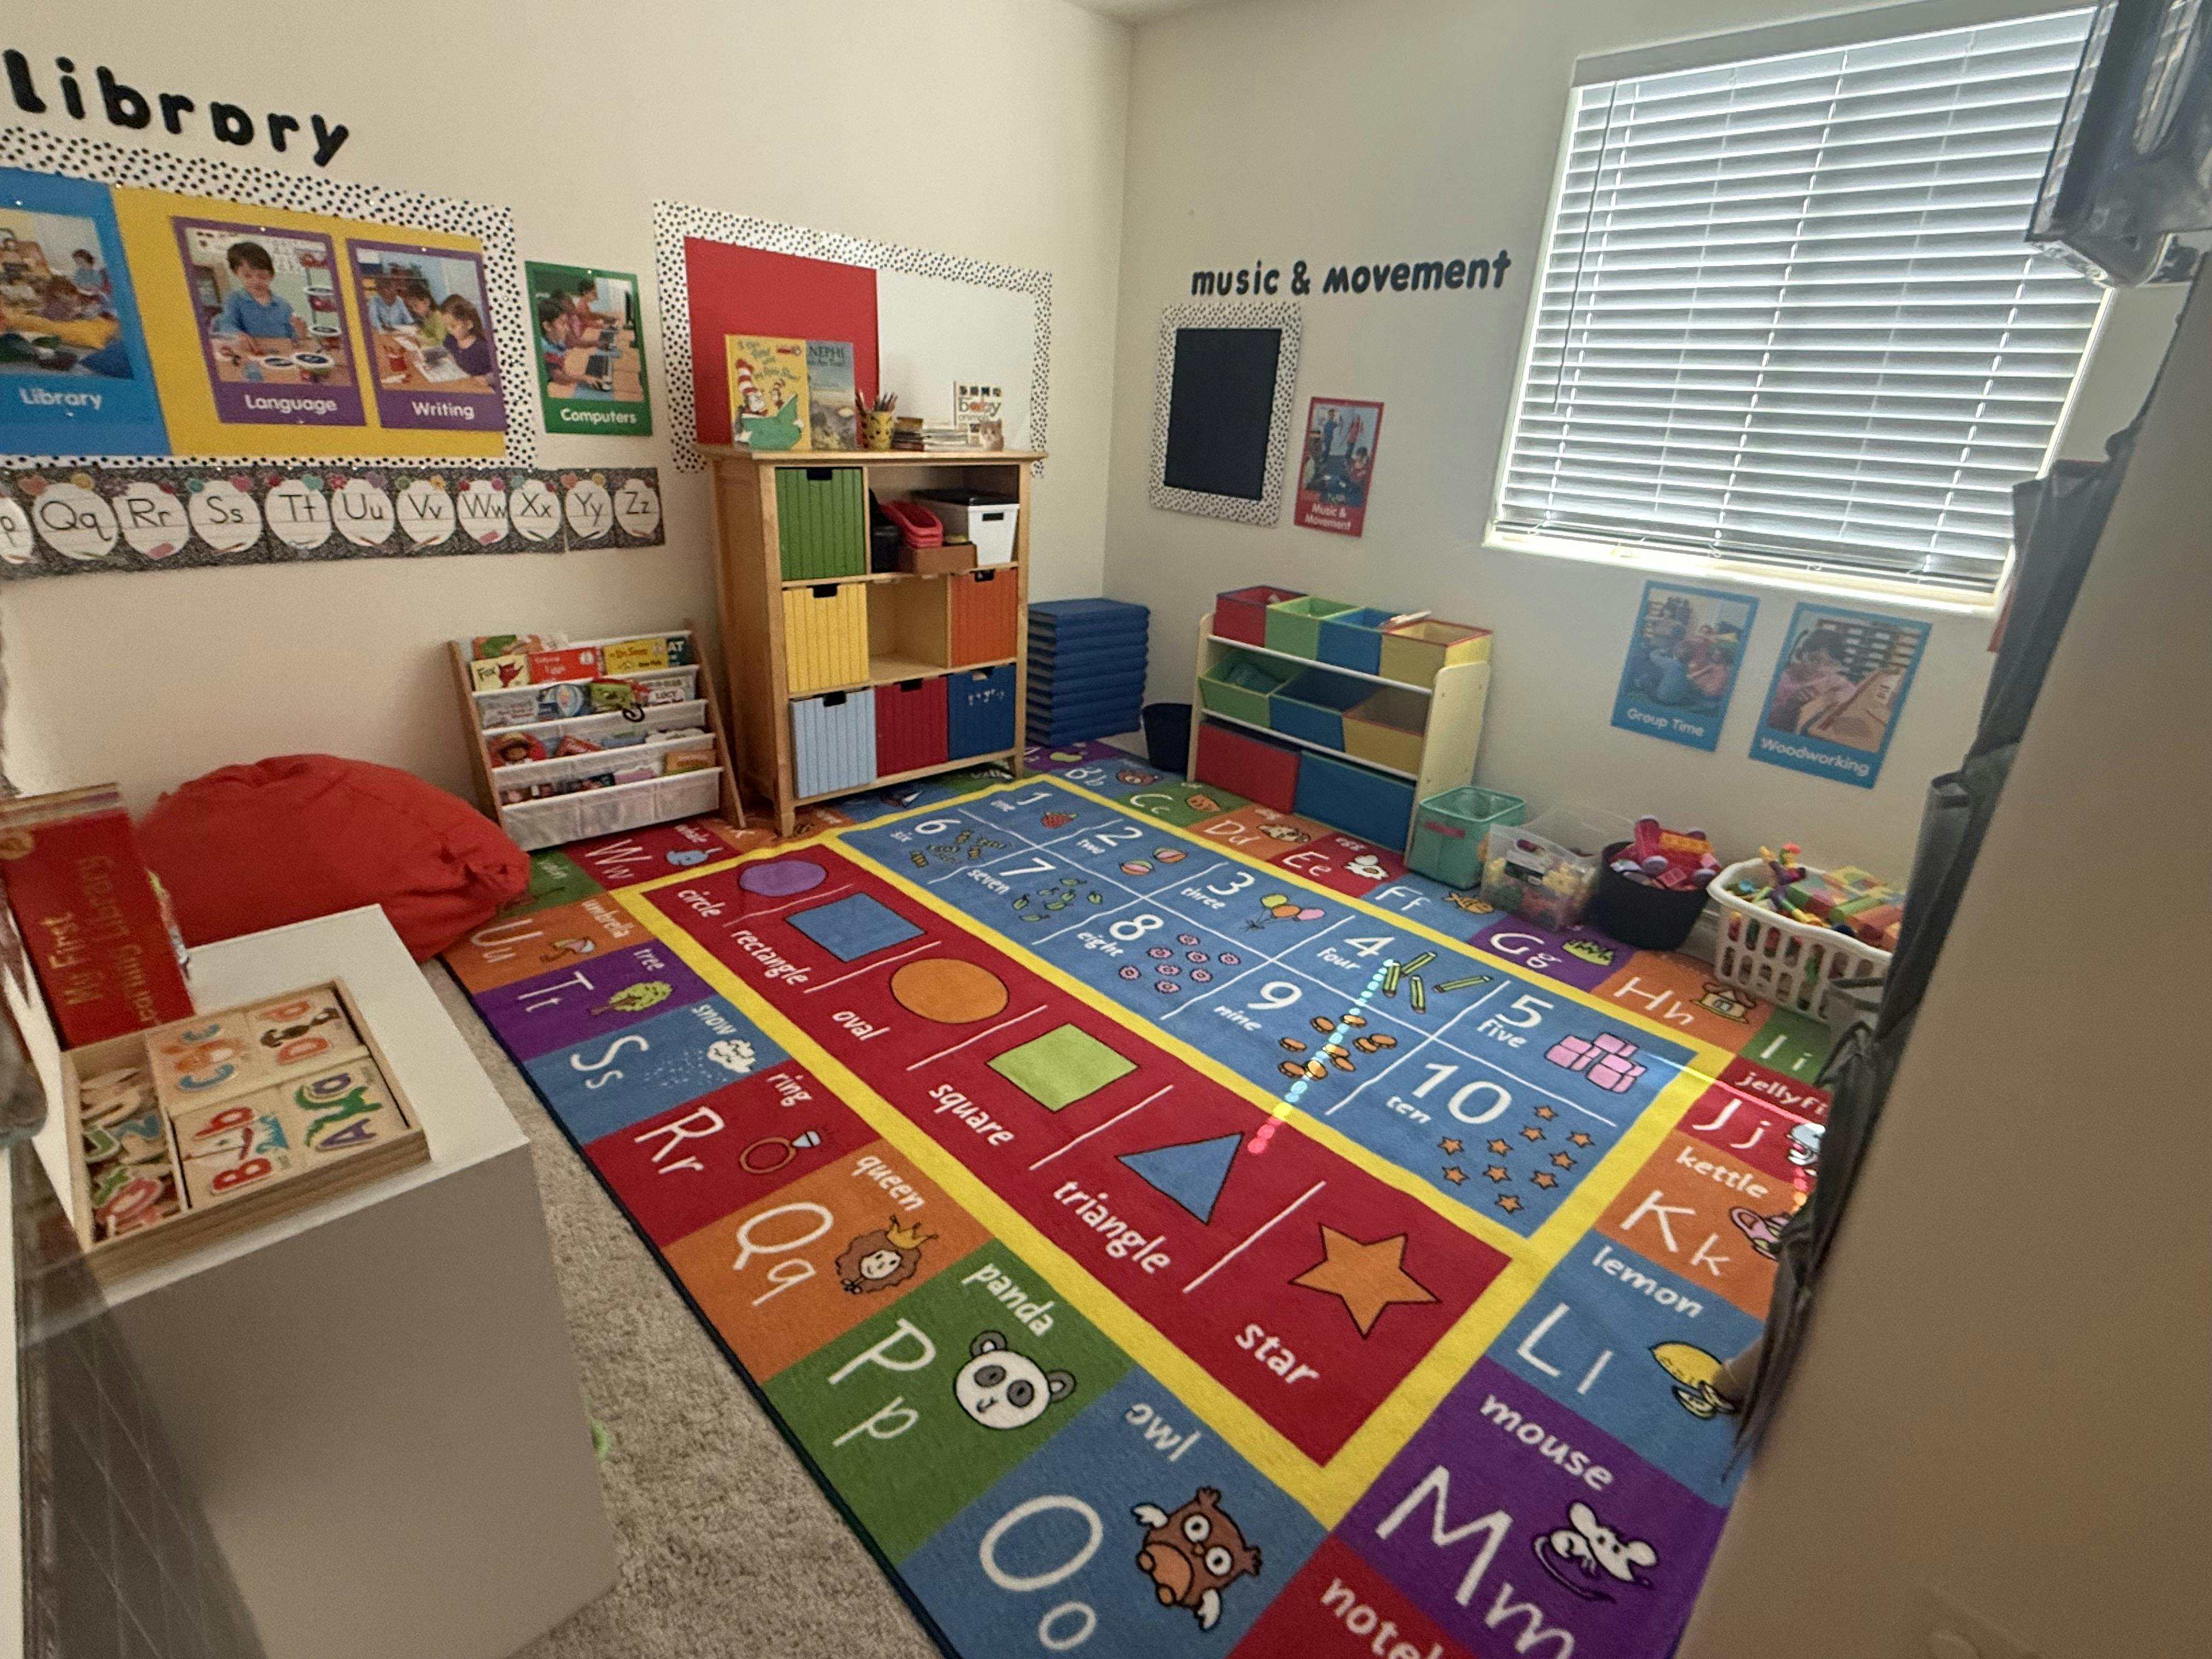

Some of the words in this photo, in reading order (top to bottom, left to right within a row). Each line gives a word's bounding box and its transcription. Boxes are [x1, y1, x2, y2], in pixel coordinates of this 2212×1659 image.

[3, 48, 349, 167] library
[1191, 259, 1279, 296] music
[1291, 261, 1311, 296] &
[1323, 249, 1511, 294] movement
[18, 388, 102, 410] Library
[245, 394, 338, 415] Language
[411, 400, 475, 421] Writing
[560, 408, 636, 425] Computers
[1305, 513, 1352, 530] Movement
[1312, 503, 1338, 517] Music
[1339, 506, 1347, 518] &
[1628, 708, 1668, 729] Group
[1672, 718, 1705, 737] Time
[1760, 737, 1870, 777] Woodworking
[915, 819, 962, 835] 6
[1095, 827, 1143, 847] 2
[998, 857, 1057, 877] 7
[967, 869, 1012, 896] seven
[1207, 871, 1255, 896] 3
[678, 889, 726, 917] circle
[1180, 887, 1227, 911] three
[40, 911, 86, 969] First
[1109, 913, 1164, 941] 8
[731, 929, 811, 985] rectangle
[1077, 932, 1124, 957] eight
[1317, 947, 1361, 971] four
[1344, 936, 1395, 957] 4
[633, 948, 665, 972] tree
[1247, 981, 1302, 1010] 9
[691, 1003, 737, 1035] snow
[832, 1011, 890, 1041] oval
[1214, 1005, 1262, 1031] nine
[1495, 994, 1554, 1029] 5
[1476, 1017, 1528, 1048] five
[767, 1073, 812, 1108] ring
[1411, 1063, 1512, 1125] 10
[1734, 1071, 1830, 1115] jellyfi
[929, 1083, 1015, 1147] square
[1386, 1096, 1431, 1124] ten
[851, 1154, 926, 1212] queen
[1675, 1146, 1769, 1199] kettle
[1052, 1181, 1171, 1274] triangle
[1592, 1245, 1704, 1318] lemon
[961, 1262, 1055, 1337] panda
[1234, 1323, 1320, 1384] star
[1124, 1402, 1202, 1463] owl
[1480, 1394, 1615, 1492] mouse
